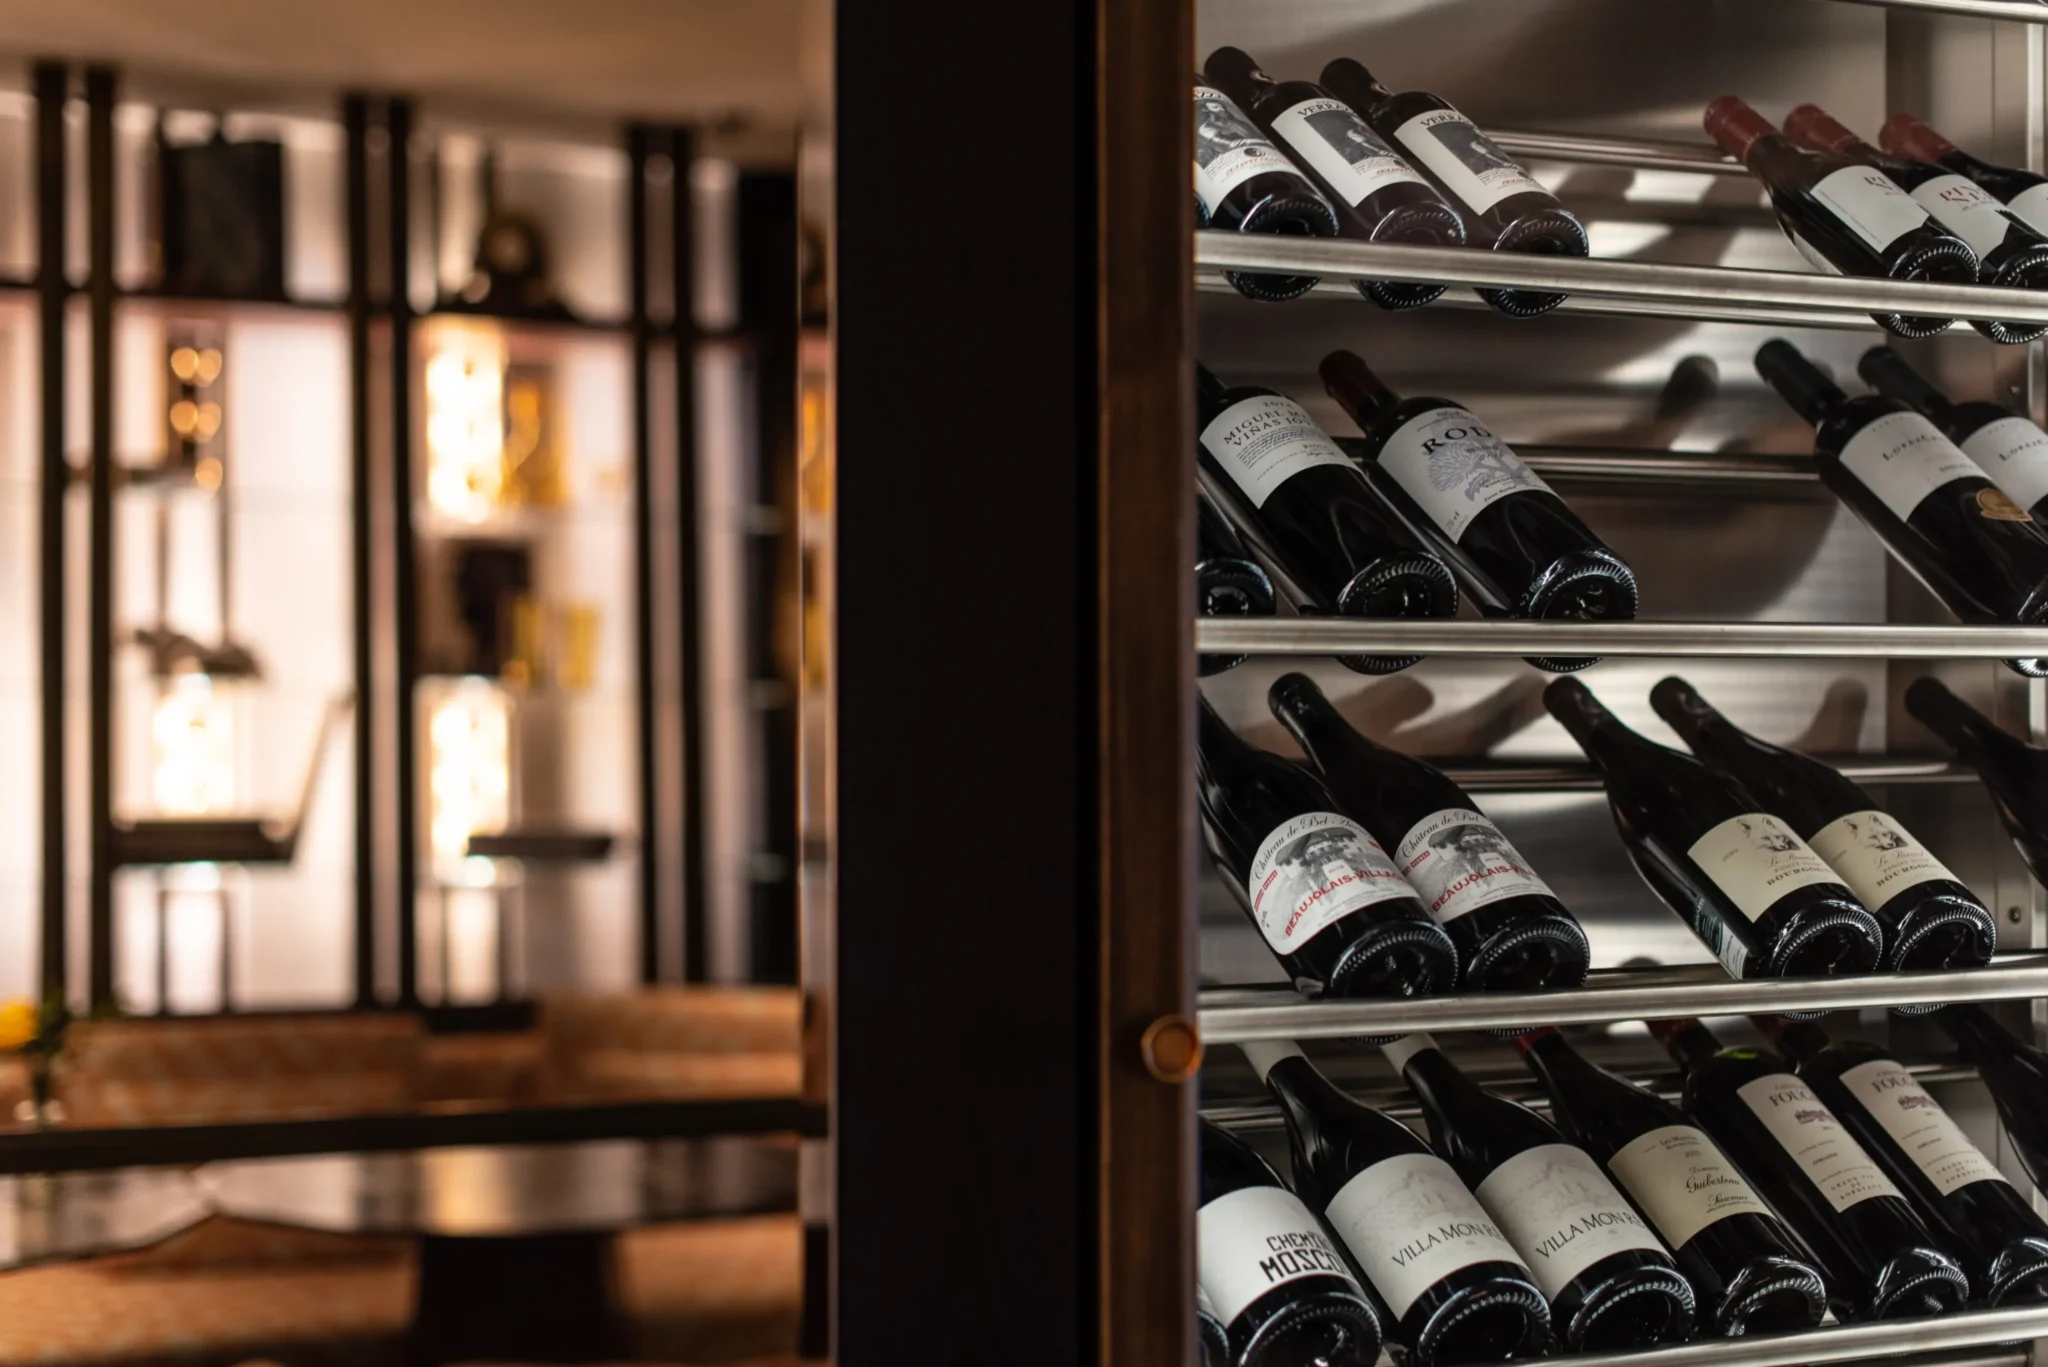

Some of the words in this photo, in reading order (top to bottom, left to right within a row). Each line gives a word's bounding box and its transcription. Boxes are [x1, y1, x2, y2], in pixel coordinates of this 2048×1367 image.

[1223, 409, 1284, 444] MIGUEL
[1233, 417, 1282, 446] VIÑAS
[1251, 836, 1285, 882] Château
[1287, 825, 1299, 839] de
[1398, 821, 1440, 859] Château
[1441, 814, 1452, 826] de
[1391, 1233, 1442, 1267] VILLA
[1535, 1223, 1584, 1258] VILLA
